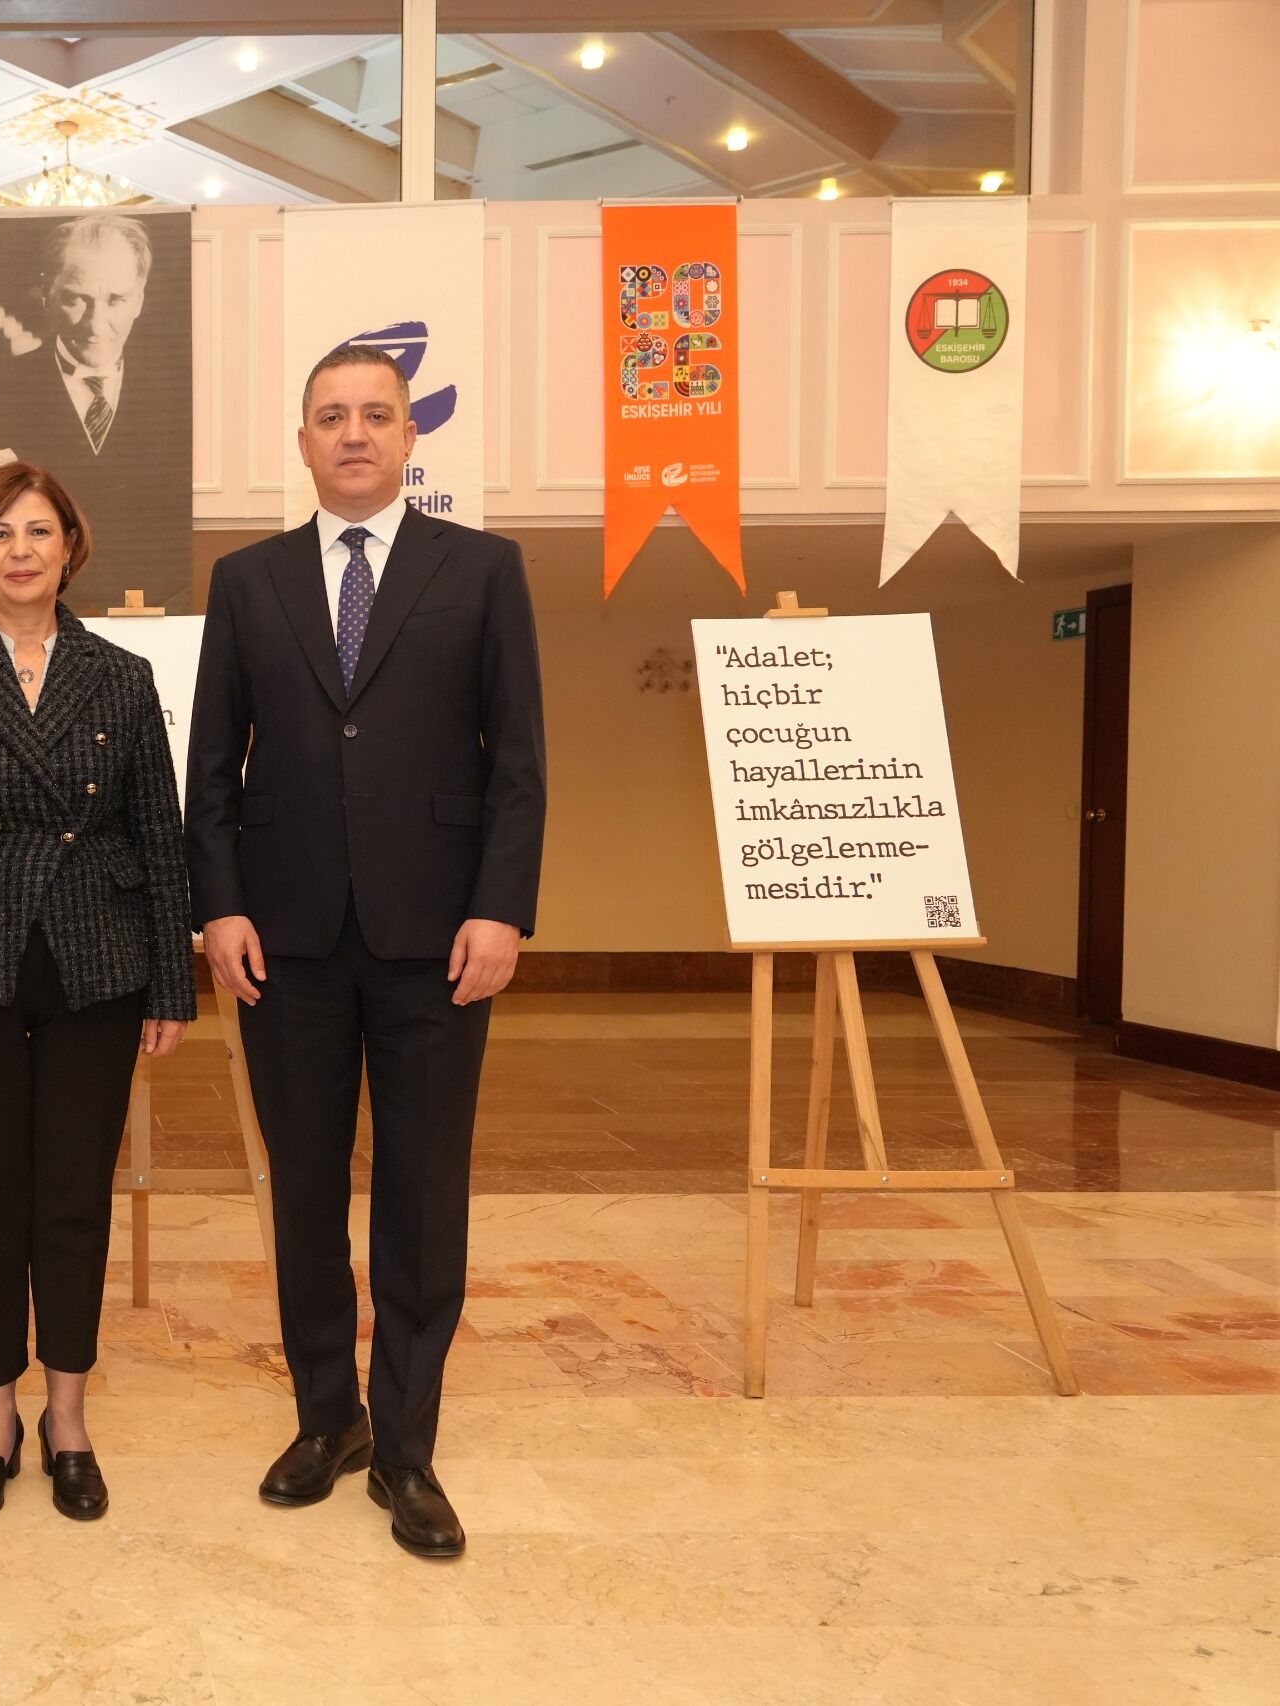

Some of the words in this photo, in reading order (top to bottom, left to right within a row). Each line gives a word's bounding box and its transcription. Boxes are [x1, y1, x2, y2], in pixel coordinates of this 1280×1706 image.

[948, 278, 969, 287] 1934
[936, 342, 985, 354] ESKİŞEHİR
[940, 354, 980, 364] BAROSU
[622, 400, 693, 420] ESKİŞEHİR
[697, 401, 722, 415] YILI
[717, 645, 833, 671] "Adalet;
[721, 683, 822, 709] hiçbir
[726, 723, 851, 749] çocuğun
[730, 757, 923, 788] hayallerinin
[735, 795, 945, 821] imkânsızlıkla
[741, 836, 930, 867] gölgelenme-
[745, 873, 882, 900] mesidir."
